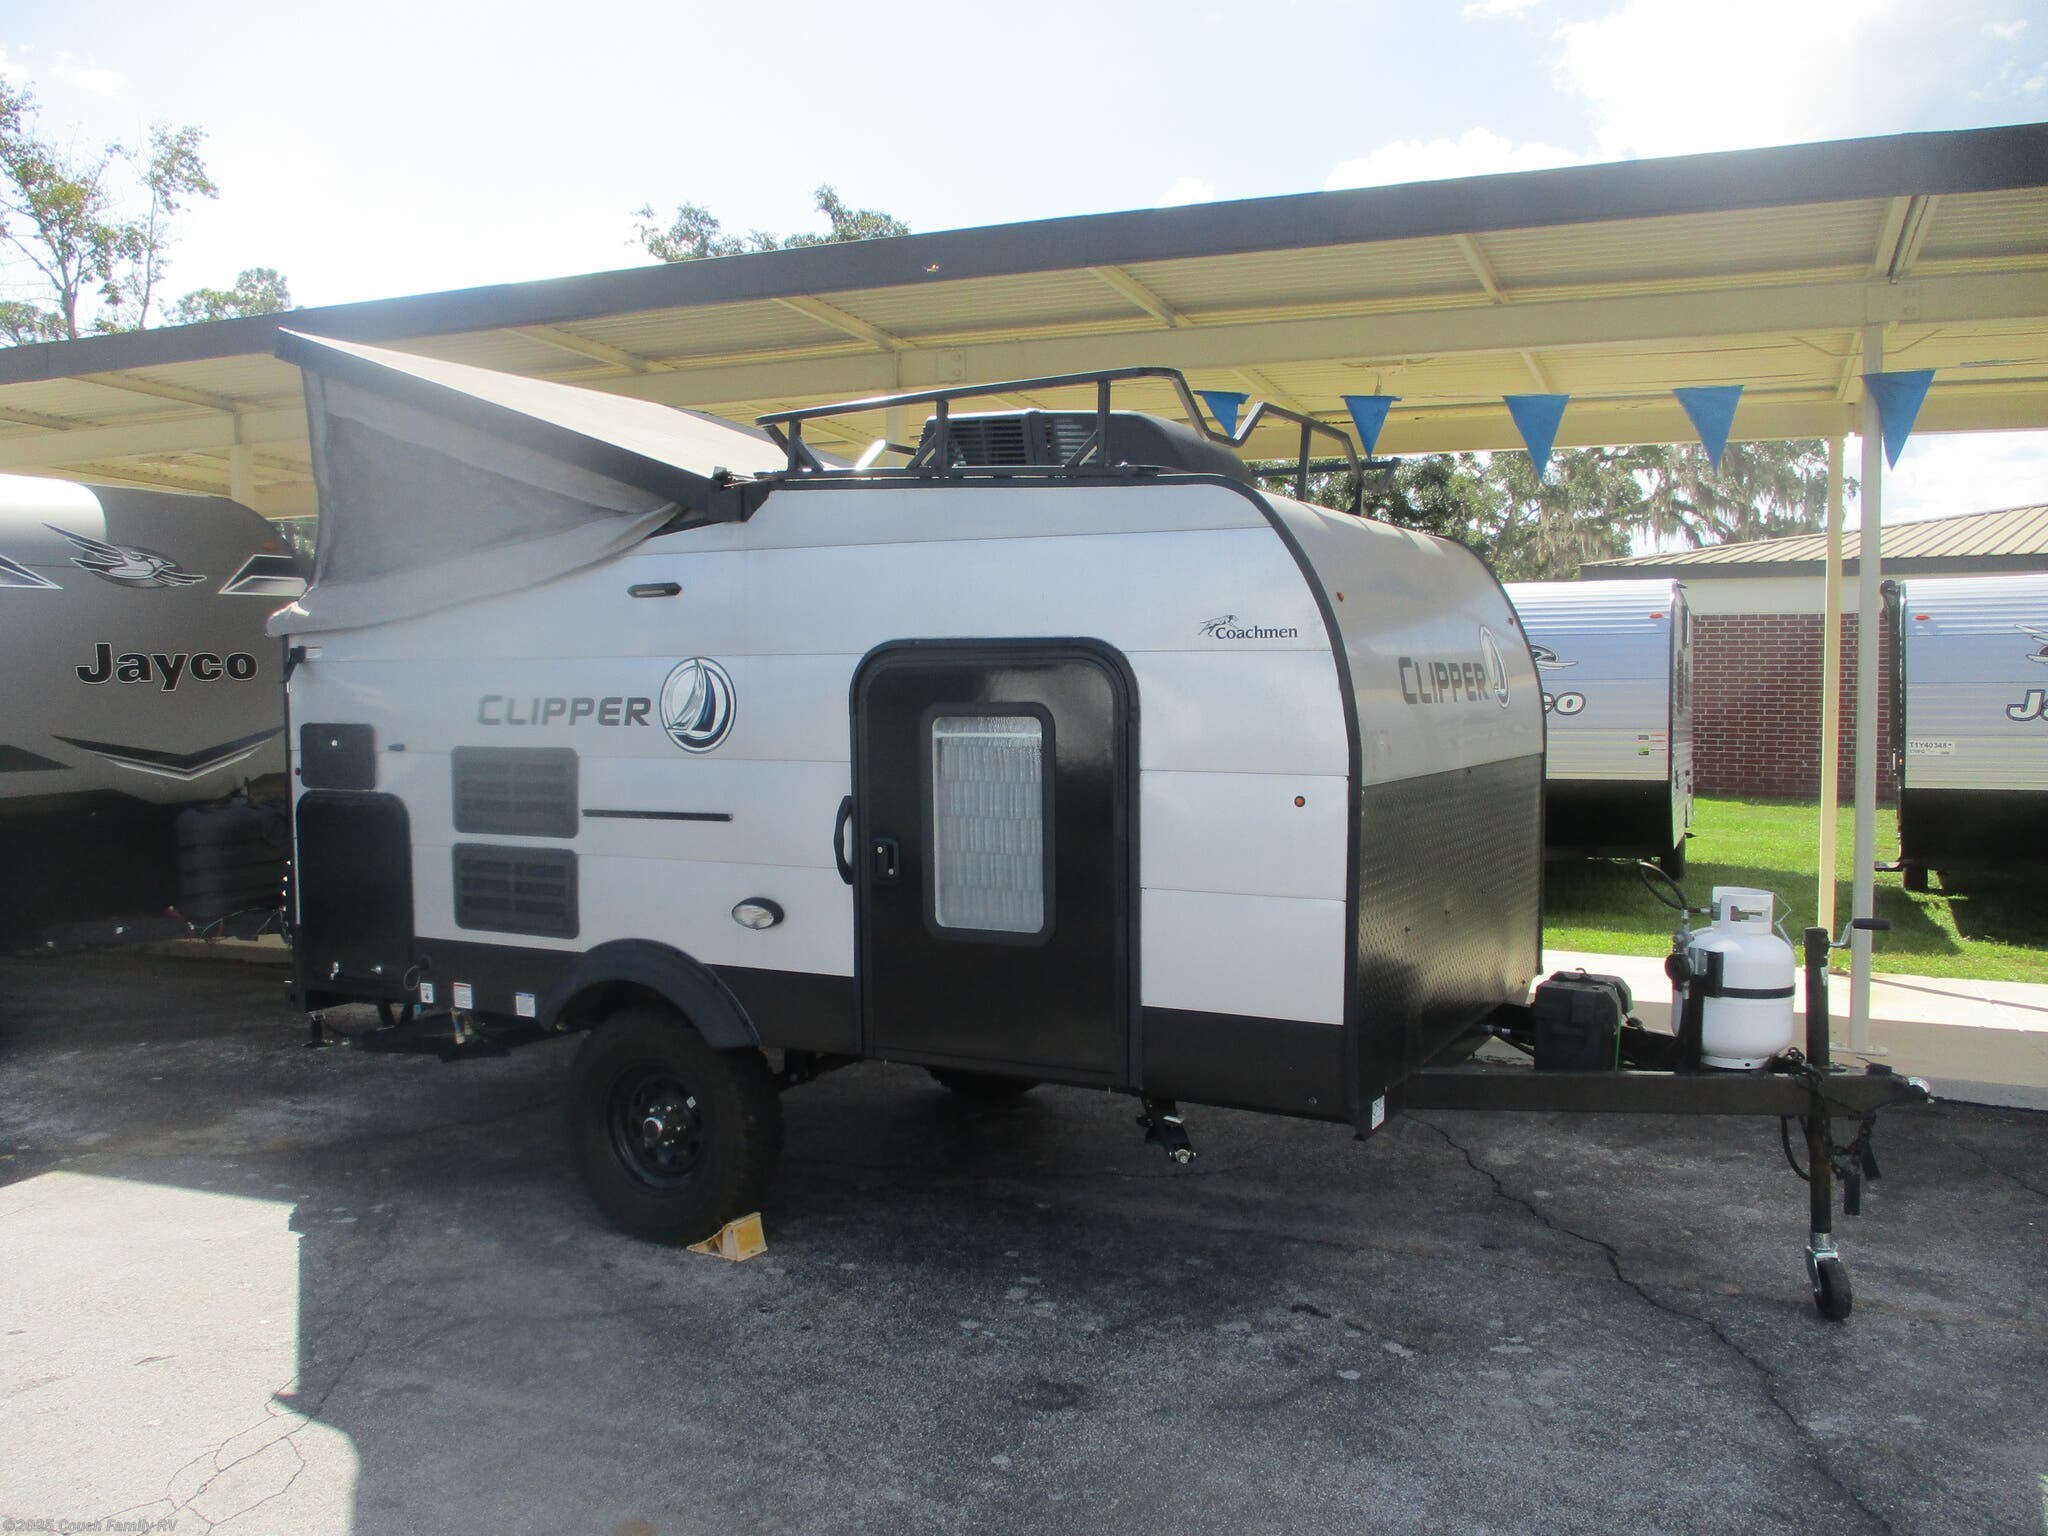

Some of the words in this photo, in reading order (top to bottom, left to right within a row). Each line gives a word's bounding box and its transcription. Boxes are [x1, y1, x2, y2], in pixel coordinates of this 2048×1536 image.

[1216, 625, 1298, 639] Coachmen
[75, 642, 259, 692] Jayco
[1398, 656, 1490, 705] CLIPPER
[477, 694, 652, 727] CLIPPER
[2006, 689, 2048, 722] J
